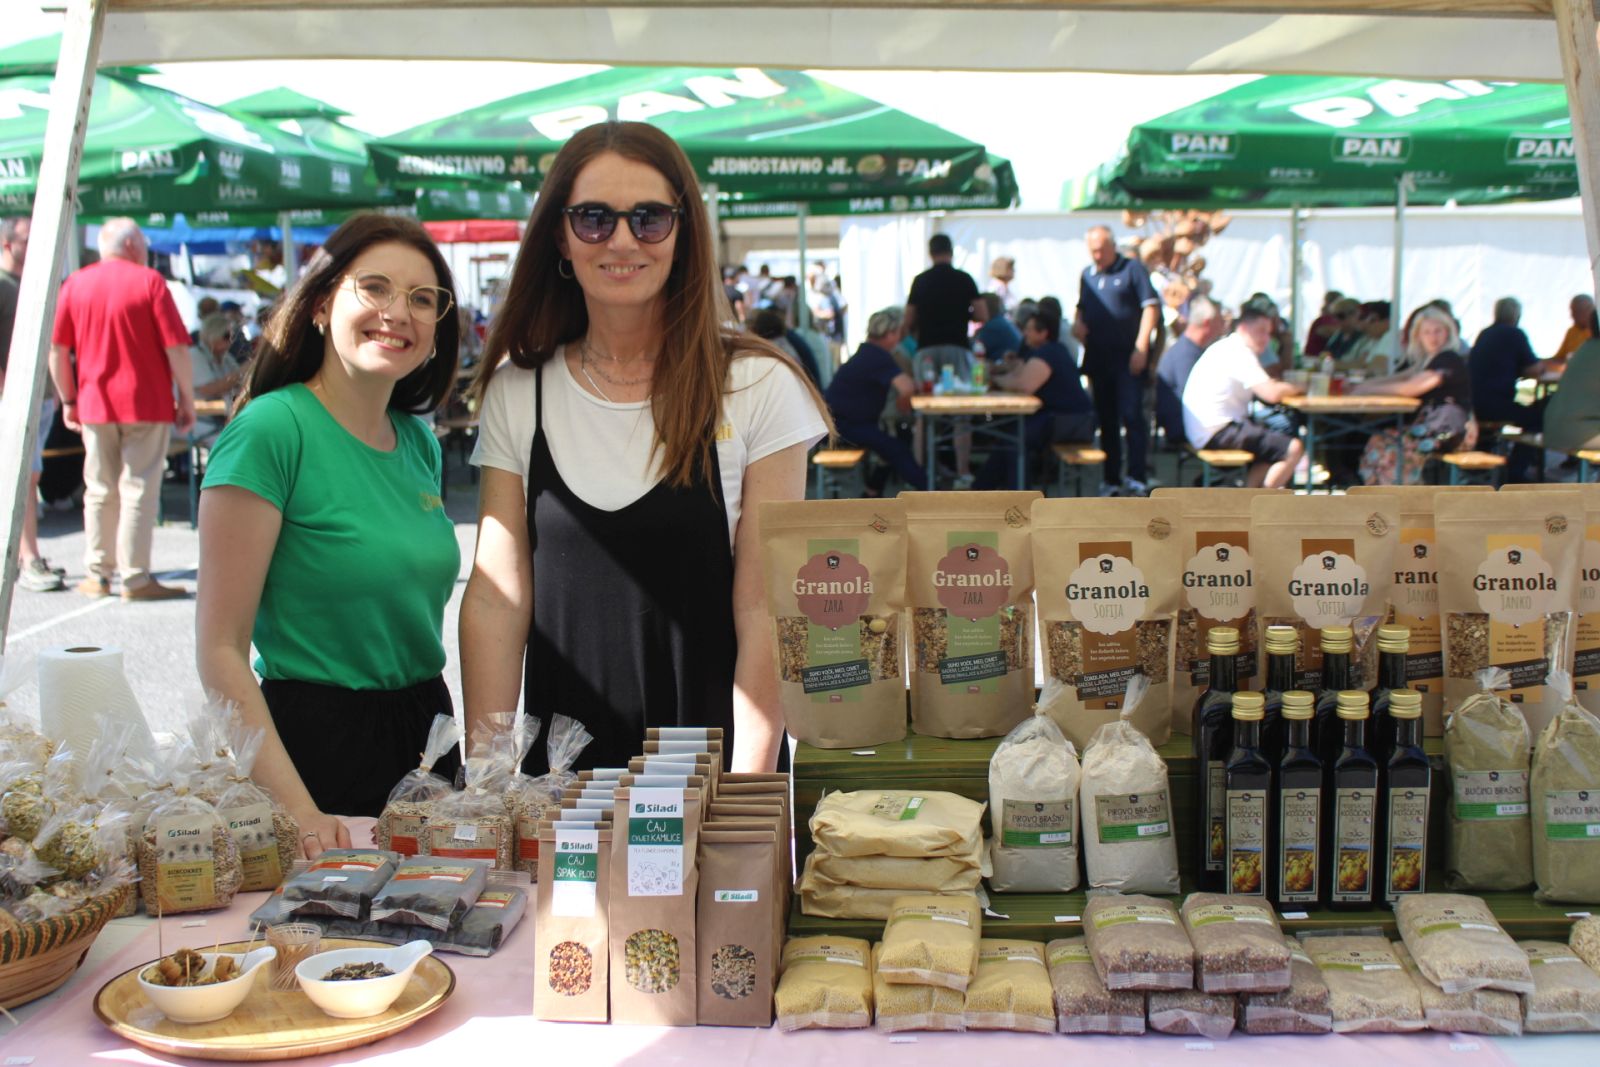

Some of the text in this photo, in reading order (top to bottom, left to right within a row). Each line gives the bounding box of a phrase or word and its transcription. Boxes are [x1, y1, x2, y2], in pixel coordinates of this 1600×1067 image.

[1171, 134, 1230, 152] PAN
[1342, 139, 1402, 157] PAN
[1516, 139, 1576, 158] PAN
[121, 150, 173, 172] PAN
[708, 157, 952, 178] JEDNOSTAVNO JE. PAN
[932, 569, 1014, 587] Granola
[1182, 569, 1253, 588] Granol
[1473, 573, 1557, 591] Granola
[792, 576, 874, 596] Granola
[1065, 580, 1150, 600] Granola
[1288, 578, 1369, 597] Granola
[963, 591, 984, 605] ZARA
[1501, 594, 1532, 611] JANKO
[823, 599, 844, 613] ZARA
[1465, 784, 1522, 795] BUČINO BRAŠNO
[647, 804, 678, 813] Siladi
[1107, 804, 1161, 817] PIROVO BRAŠNO
[1554, 805, 1582, 816] BUČINO
[239, 816, 261, 828] Siladi
[1012, 812, 1065, 823] PIROVO BRAŠNO
[176, 828, 201, 837] Siladi
[646, 819, 667, 833] ČAJ
[650, 833, 681, 842] KAMILICE
[570, 842, 593, 850] Siladi
[567, 854, 585, 866] ČAJ
[556, 866, 596, 879] ŠIPAK PLOD
